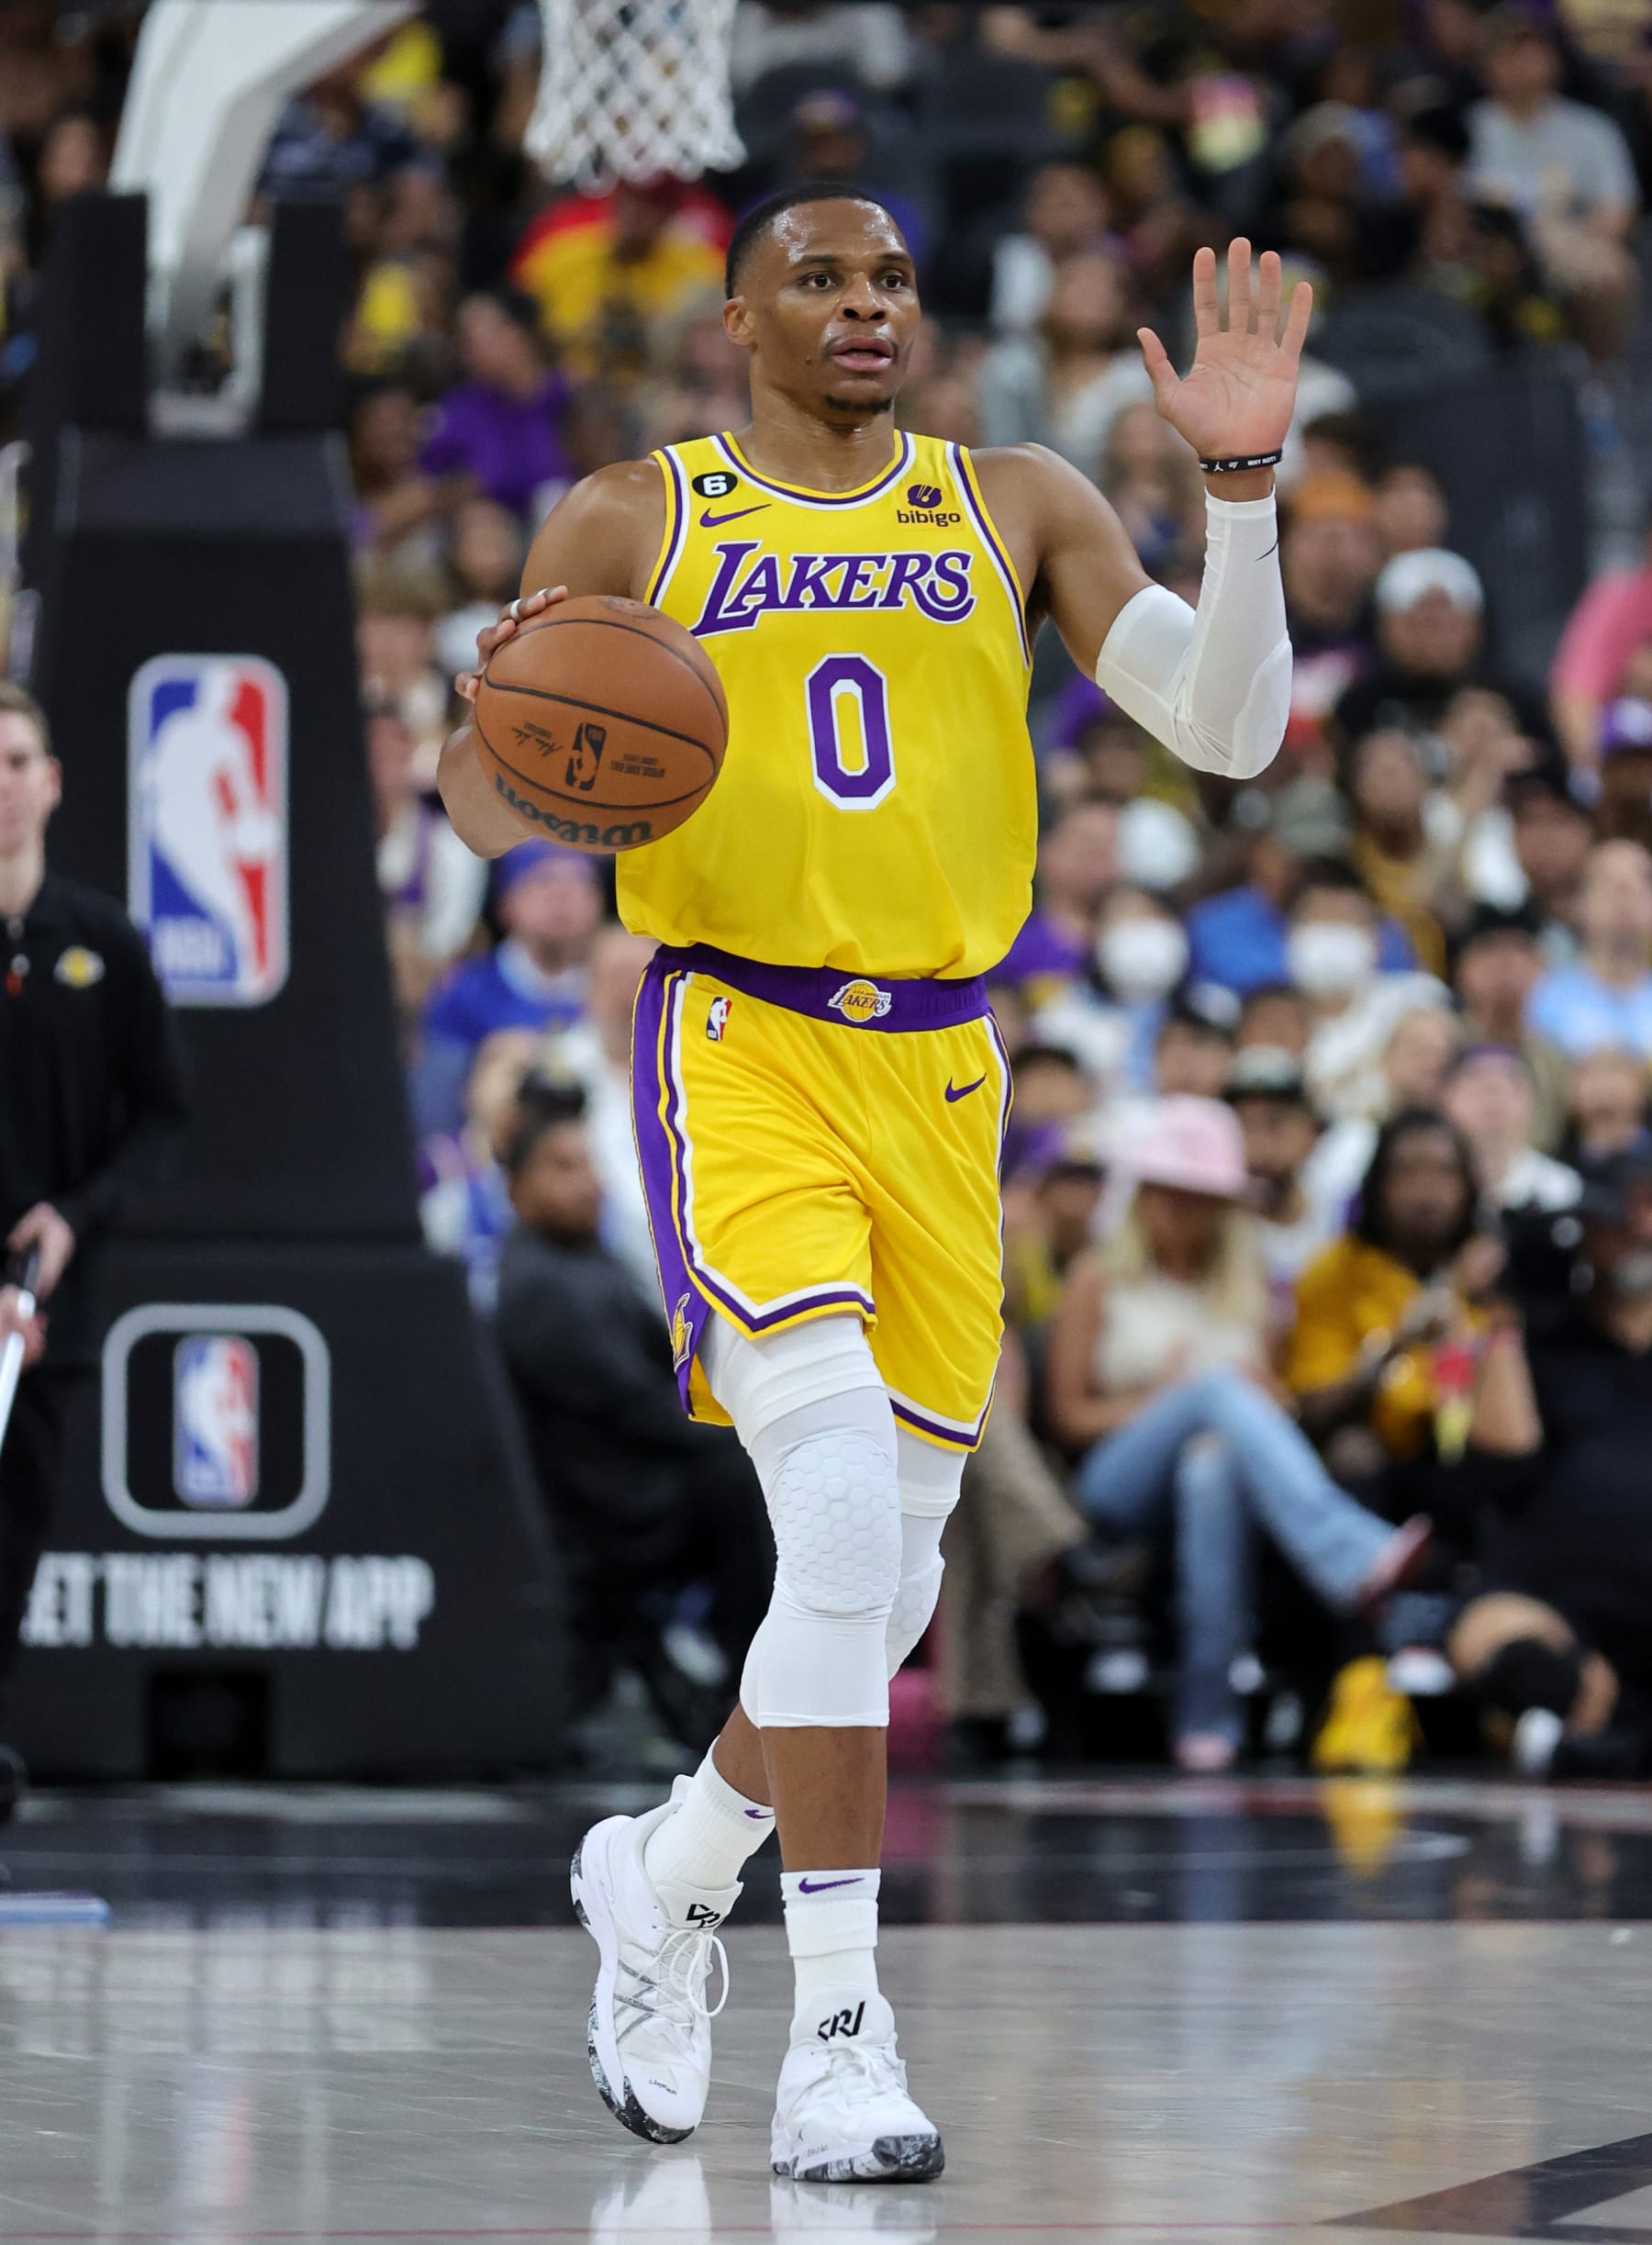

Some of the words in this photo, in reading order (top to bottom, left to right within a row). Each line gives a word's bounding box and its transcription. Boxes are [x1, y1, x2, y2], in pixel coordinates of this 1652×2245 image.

[703, 474, 728, 497] 6
[897, 509, 961, 527] bibigo
[690, 539, 977, 640] LAKERS
[804, 652, 897, 811] 0
[495, 772, 653, 846] Wilson
[831, 987, 890, 1016] LAKERS
[18, 1551, 96, 1647] ET
[97, 1551, 202, 1648] THE
[204, 1553, 320, 1648] NEW
[323, 1555, 436, 1650] APP
